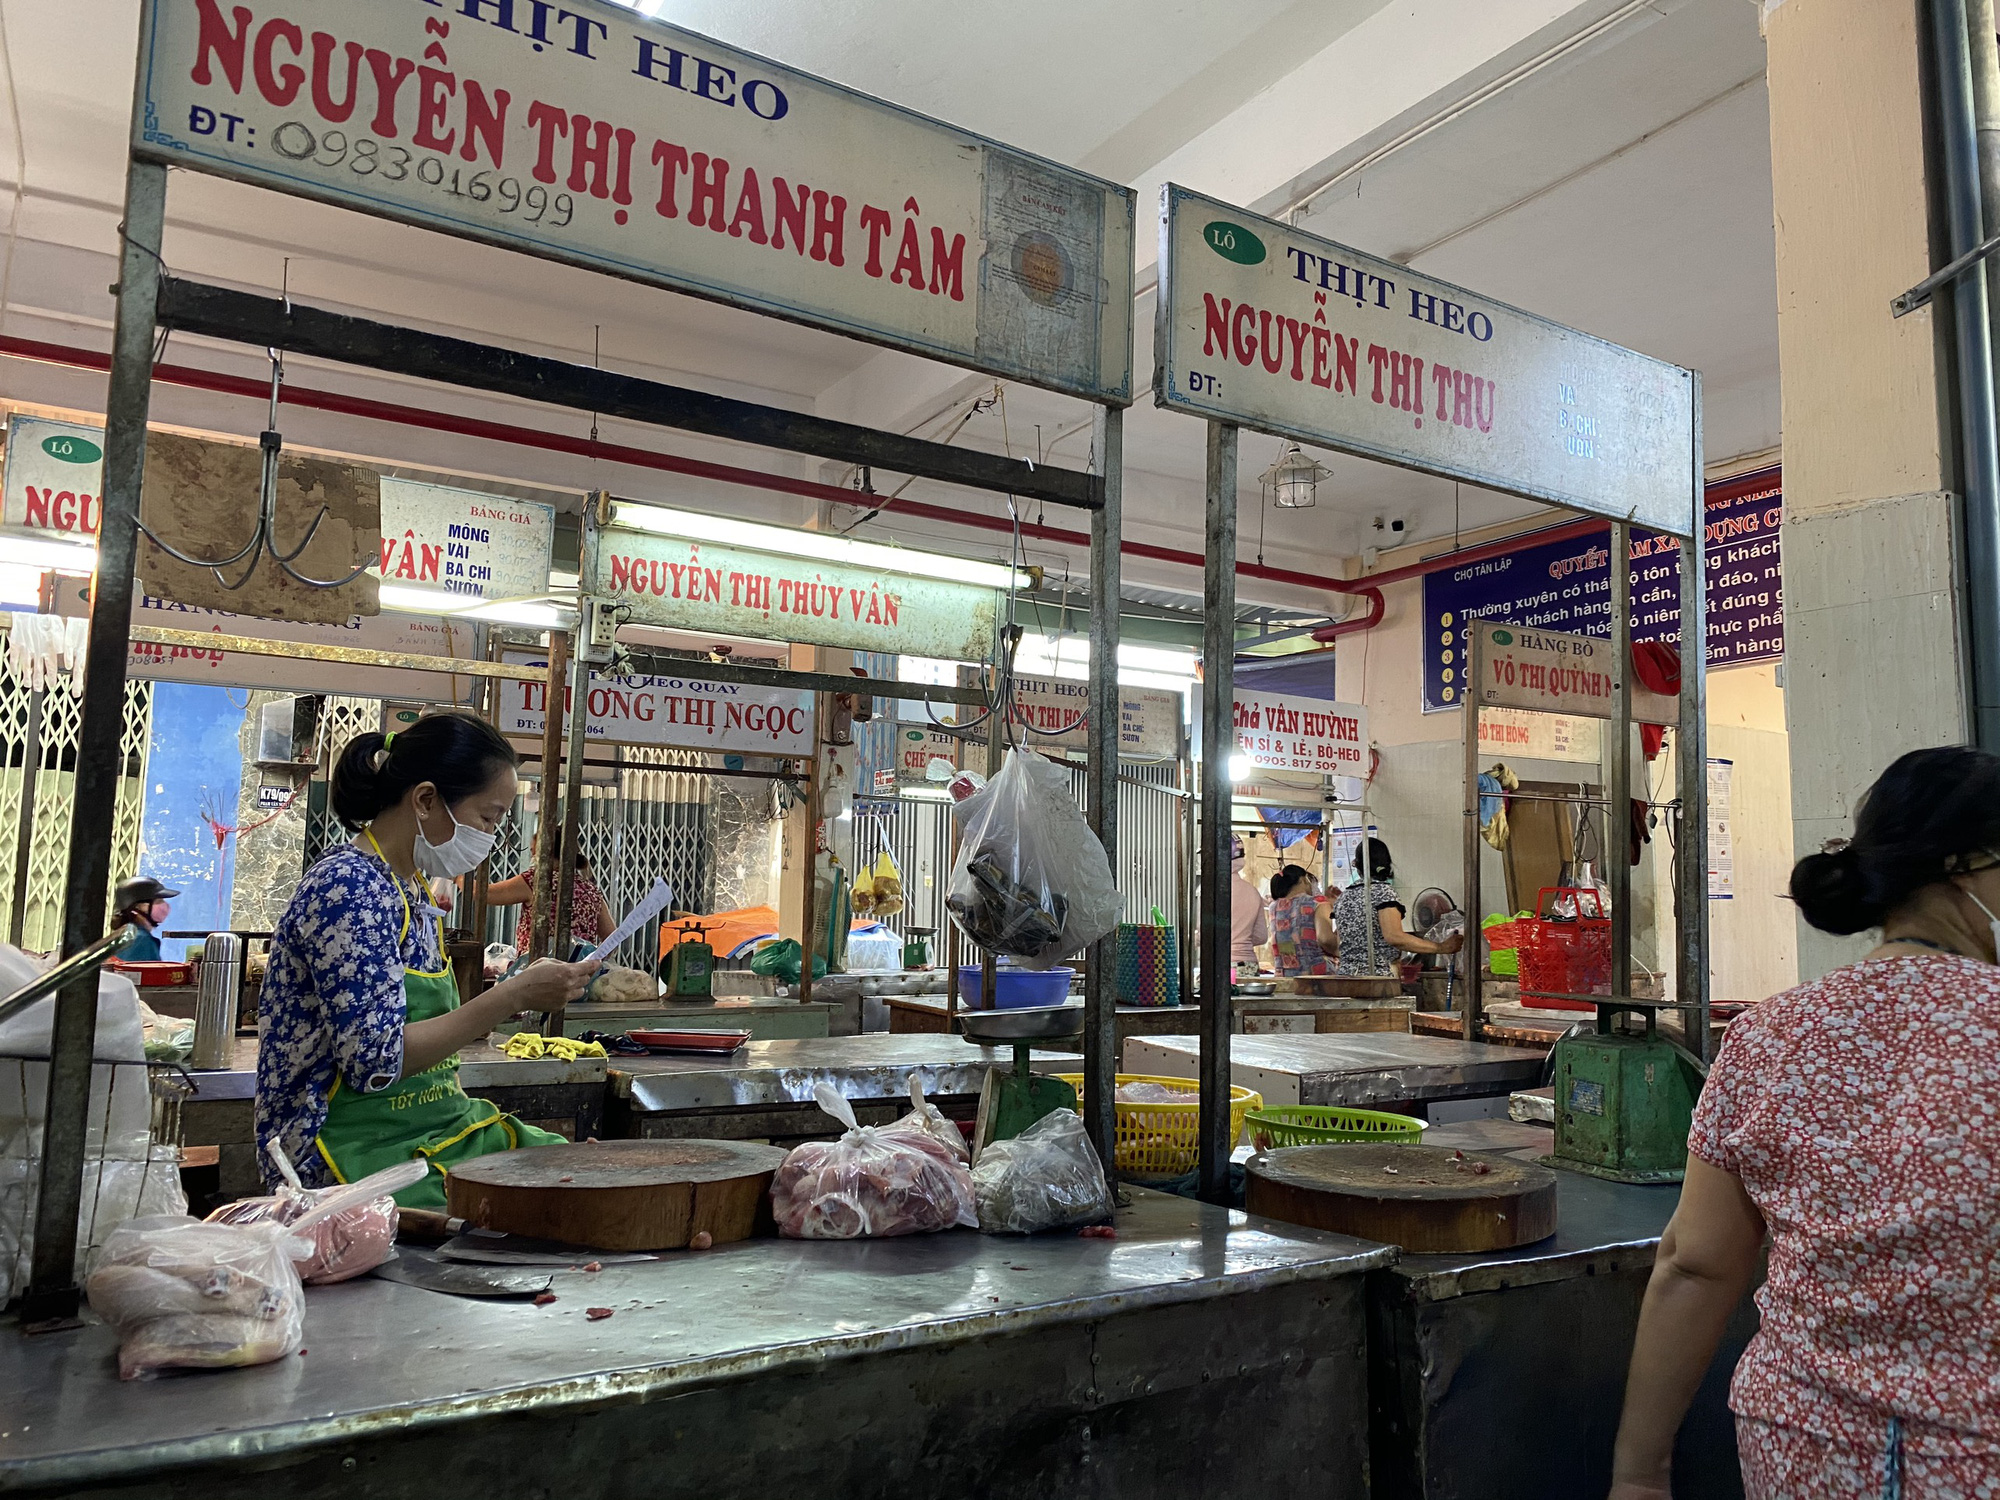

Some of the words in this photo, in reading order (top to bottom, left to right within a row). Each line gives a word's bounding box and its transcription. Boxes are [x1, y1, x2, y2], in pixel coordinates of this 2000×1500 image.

[425, 0, 608, 61] HỊT
[631, 35, 789, 121] HEO
[189, 105, 256, 148] ĐT:
[270, 121, 574, 228] 0983016999
[190, 0, 511, 170] NGUYỄN
[527, 100, 636, 226] THỊ
[651, 139, 847, 268] THANH
[860, 196, 966, 302] TÂM
[1213, 230, 1236, 250] LÔ
[1287, 246, 1396, 310] THỊT
[1408, 288, 1494, 342] HEO
[1202, 290, 1360, 397] NGUYỄN
[1367, 343, 1425, 429] THỊ
[1432, 362, 1496, 434] THU
[1189, 370, 1222, 398] ĐT:
[51, 441, 73, 455] LÔ
[23, 486, 102, 534] NGU
[469, 504, 506, 521] BẢNG
[509, 512, 531, 525] GIÁ
[448, 522, 490, 543] MÔNG
[445, 561, 464, 577] BA
[1454, 567, 1474, 583] CHỢ
[1475, 563, 1493, 577] TÂN
[1495, 557, 1513, 574] LẬP
[1548, 545, 1609, 580] QUYẾT
[1628, 538, 1652, 560] ÂM
[610, 544, 723, 604] NGUYỄN
[728, 571, 772, 620] THỊ
[778, 574, 844, 620] THÙY
[850, 581, 900, 627] VÂN
[1443, 615, 1450, 625] 1
[1460, 600, 1511, 622] Thường
[1515, 590, 1559, 610] xuyên
[1562, 584, 1581, 599] có
[1629, 571, 1639, 586] ộ
[1643, 566, 1670, 581] tôn
[1443, 634, 1451, 644] 2
[1525, 608, 1569, 629] khách
[1573, 600, 1612, 618] hàng
[1641, 586, 1676, 604] cần,
[1719, 570, 1759, 588] đáo,
[410, 621, 439, 633] BẢNG
[1444, 653, 1451, 662] 3
[1629, 614, 1639, 628] ó
[1721, 592, 1770, 612] đúng
[1444, 672, 1451, 681] 4
[1747, 606, 1783, 632] phẩ
[1519, 632, 1568, 655] HÀNG
[1571, 640, 1594, 657] BÒ
[589, 670, 636, 685] TỊT
[641, 676, 684, 689] HEO
[688, 681, 741, 695] QUAY
[1444, 690, 1451, 700] 5
[1735, 635, 1784, 657] hàng
[1493, 653, 1516, 687] VÕ
[1519, 663, 1547, 697] THỊ
[1054, 684, 1089, 698] HEO
[517, 680, 656, 723] TƠNG
[664, 695, 718, 735] THỊ
[725, 701, 806, 741] NGỌC
[1233, 701, 1261, 729] Chả
[1265, 702, 1300, 735] VÂN
[1302, 710, 1360, 742] HUỲNH
[930, 733, 955, 747] THỊ
[1258, 733, 1271, 751] SỈ
[1274, 740, 1284, 753] &
[1317, 743, 1361, 762] BÒ-HEO
[1490, 723, 1505, 747] THỊ
[1505, 716, 1530, 745] HỒNG
[1315, 761, 1338, 771] 509
[260, 787, 289, 803] K79/09
